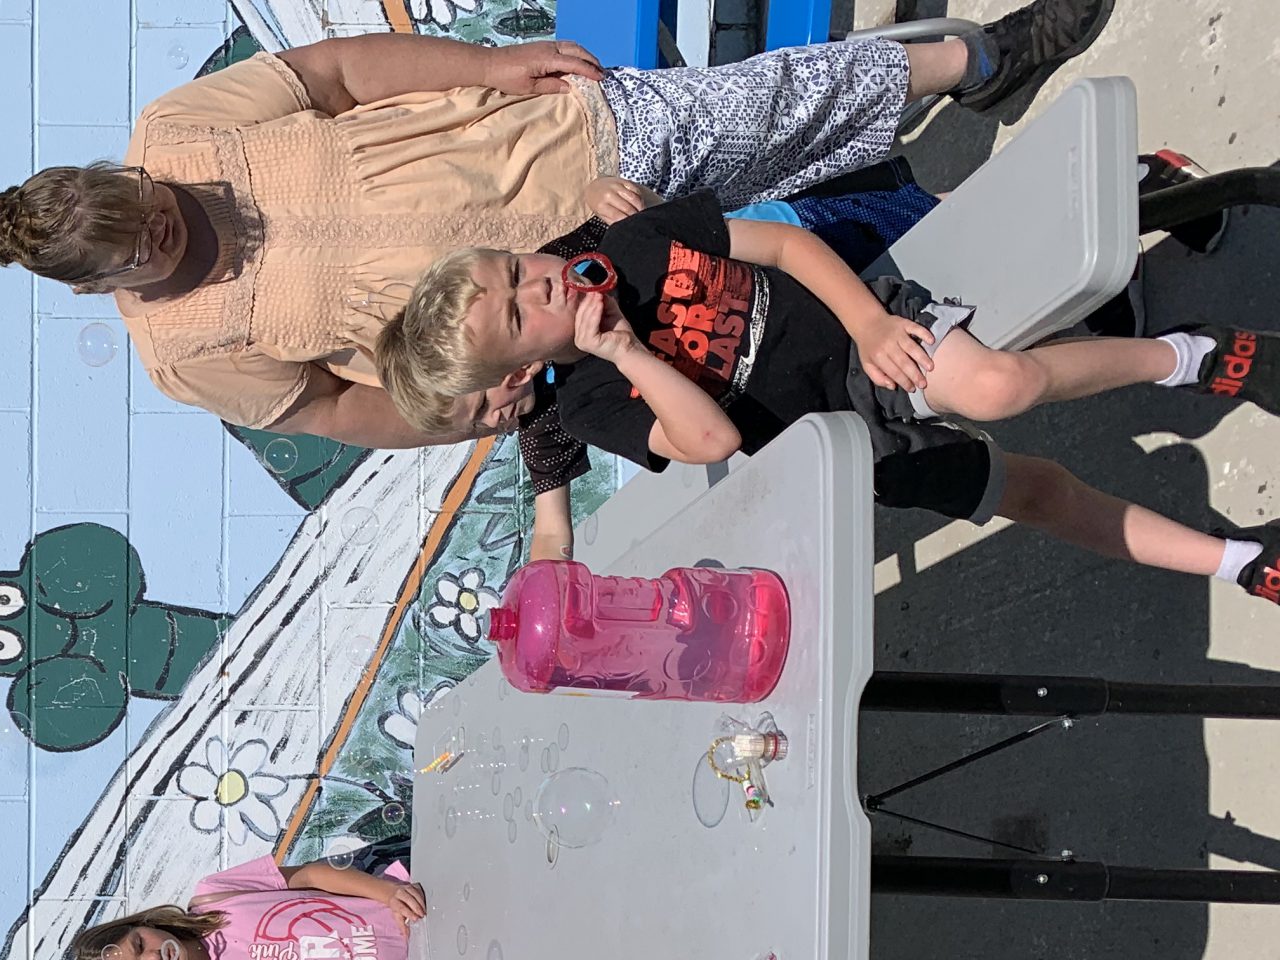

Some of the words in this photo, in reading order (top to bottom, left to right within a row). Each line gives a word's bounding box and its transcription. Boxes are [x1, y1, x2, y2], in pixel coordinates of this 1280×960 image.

[679, 303, 718, 360] OR
[707, 290, 749, 381] LAST
[1210, 331, 1256, 397] didas
